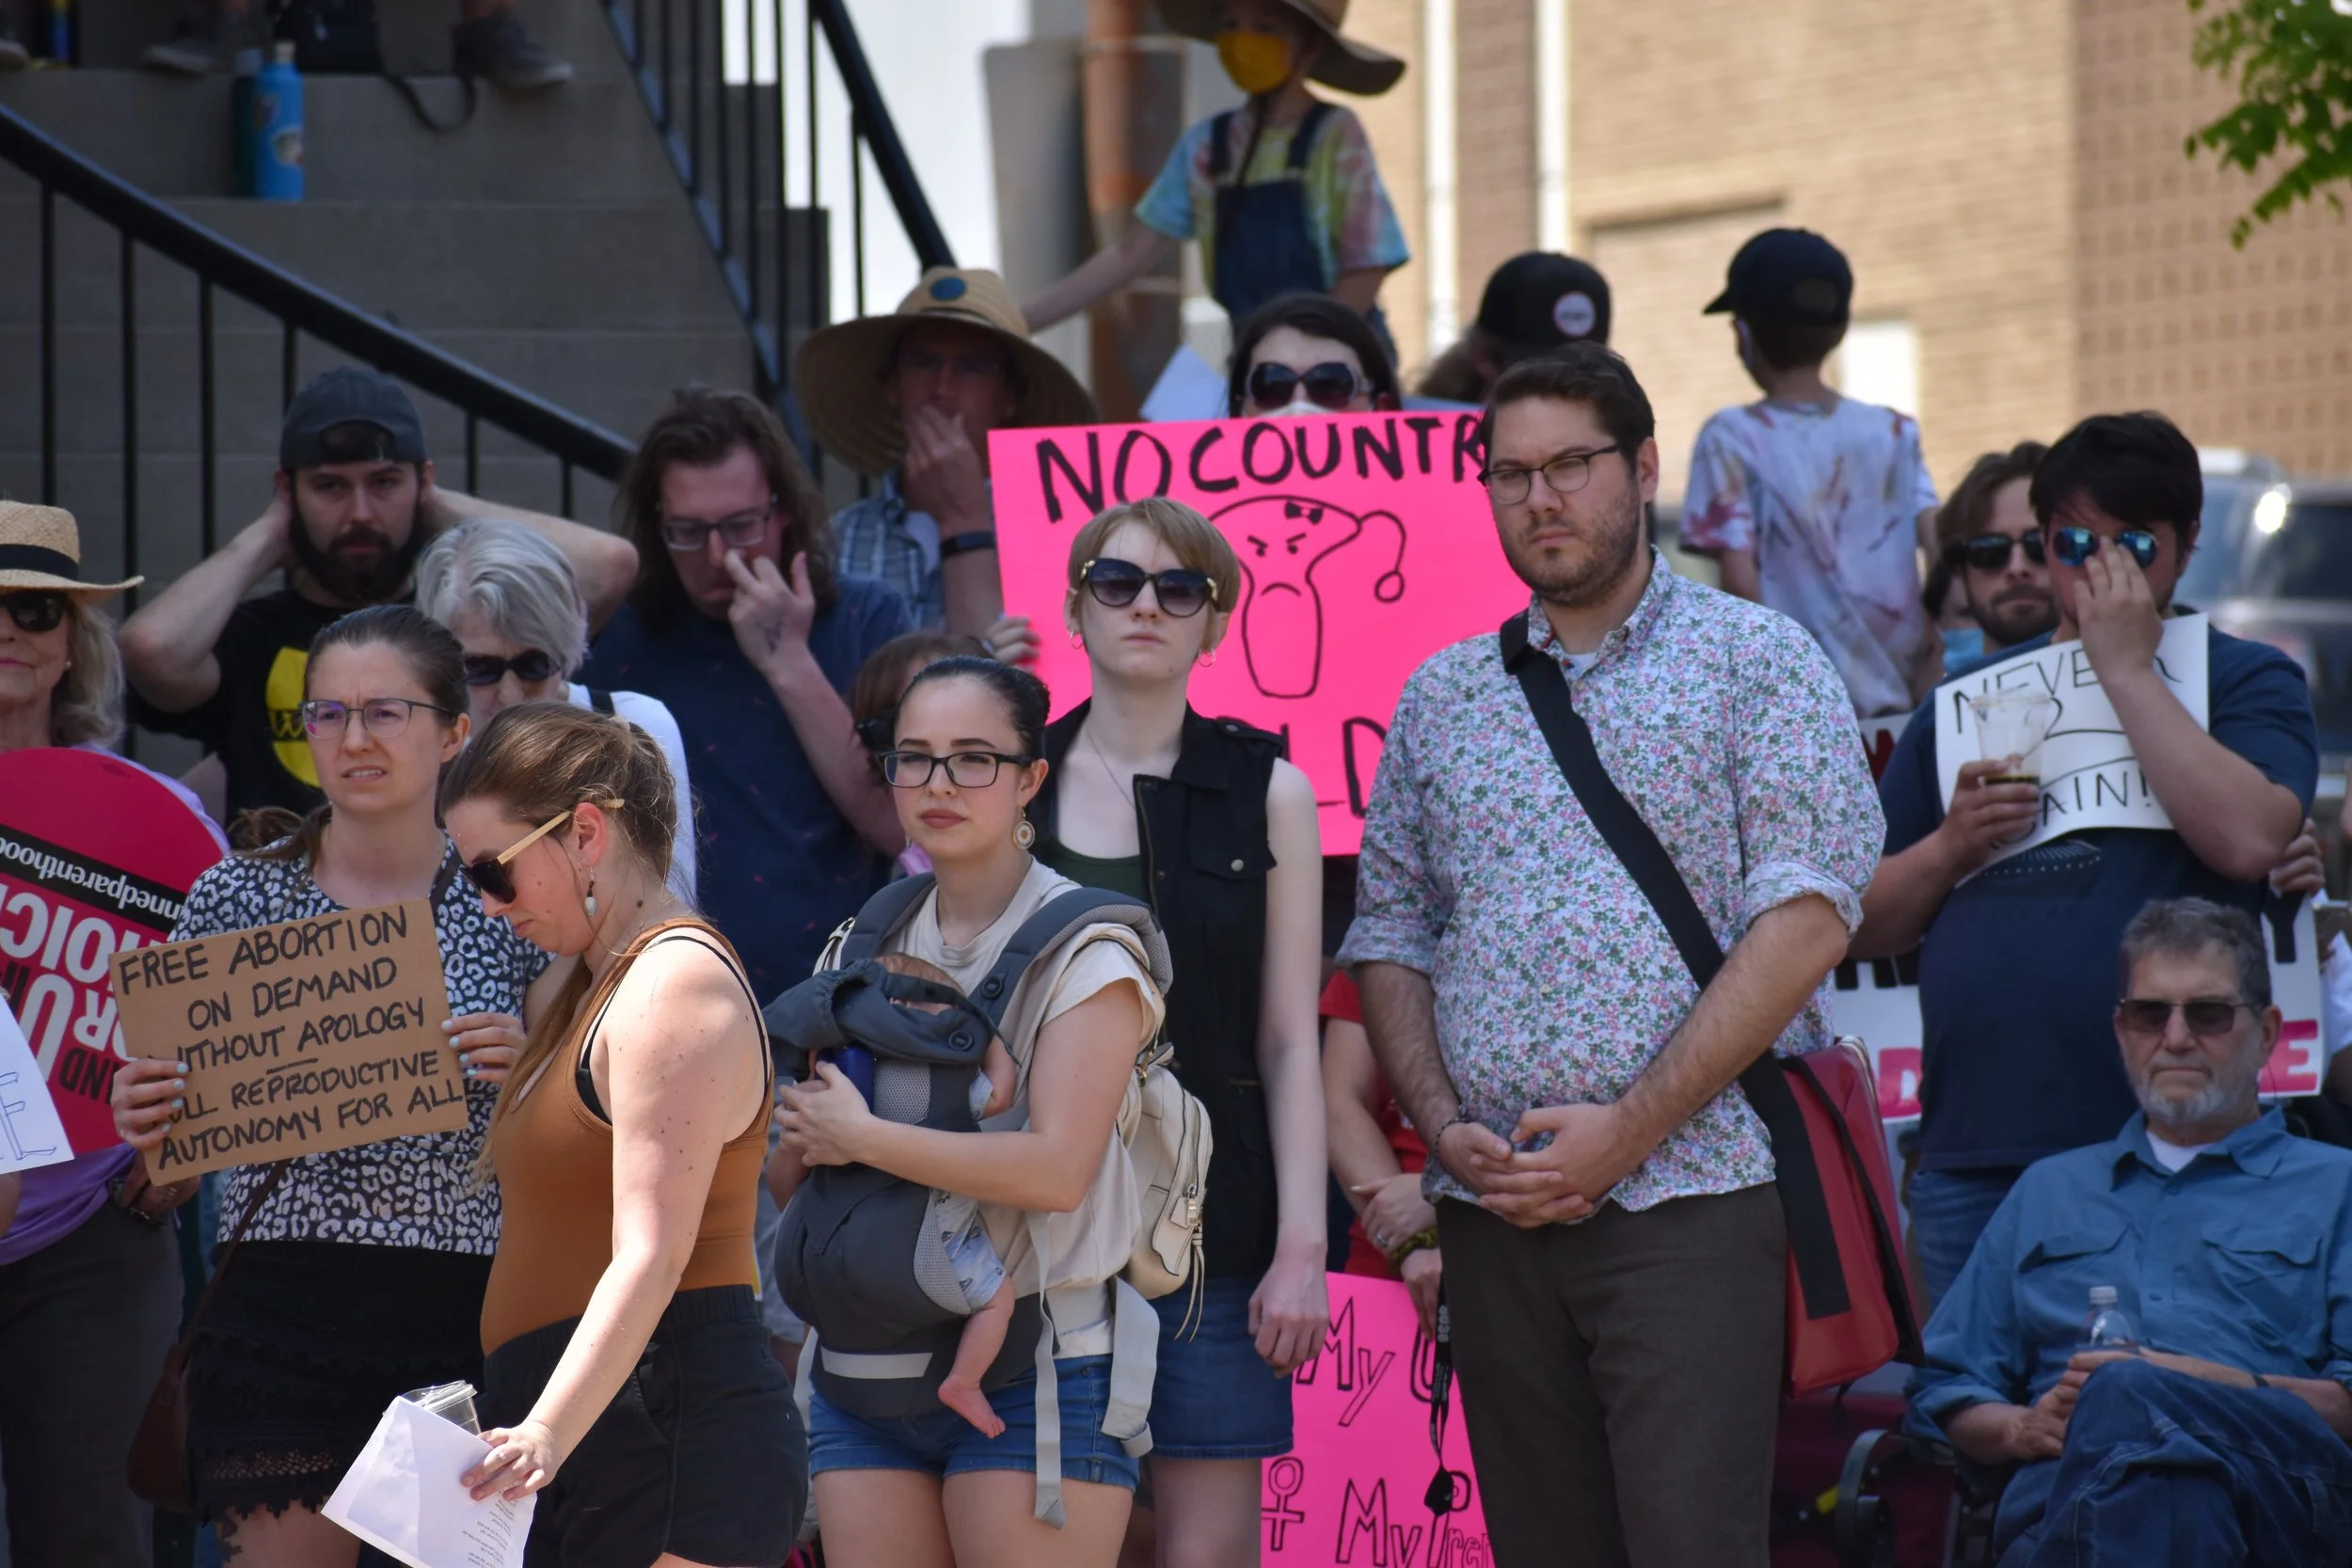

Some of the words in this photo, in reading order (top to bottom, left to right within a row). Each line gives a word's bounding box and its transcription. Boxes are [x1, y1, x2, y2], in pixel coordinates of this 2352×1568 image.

[1036, 430, 1172, 522] NO
[1953, 643, 2183, 735] NEVE
[119, 944, 209, 994] FREE
[229, 906, 406, 975] ABORTION
[188, 991, 231, 1031] ON
[252, 957, 396, 1018] DEMAND
[297, 997, 423, 1053] APOLOGY
[158, 1105, 322, 1170] AUTONOMY
[338, 1092, 392, 1129] FOR
[407, 1079, 463, 1114] ALL
[231, 1050, 439, 1110] REPRODUCTIVE
[1296, 1296, 1396, 1427] My
[1336, 1478, 1423, 1568] My
